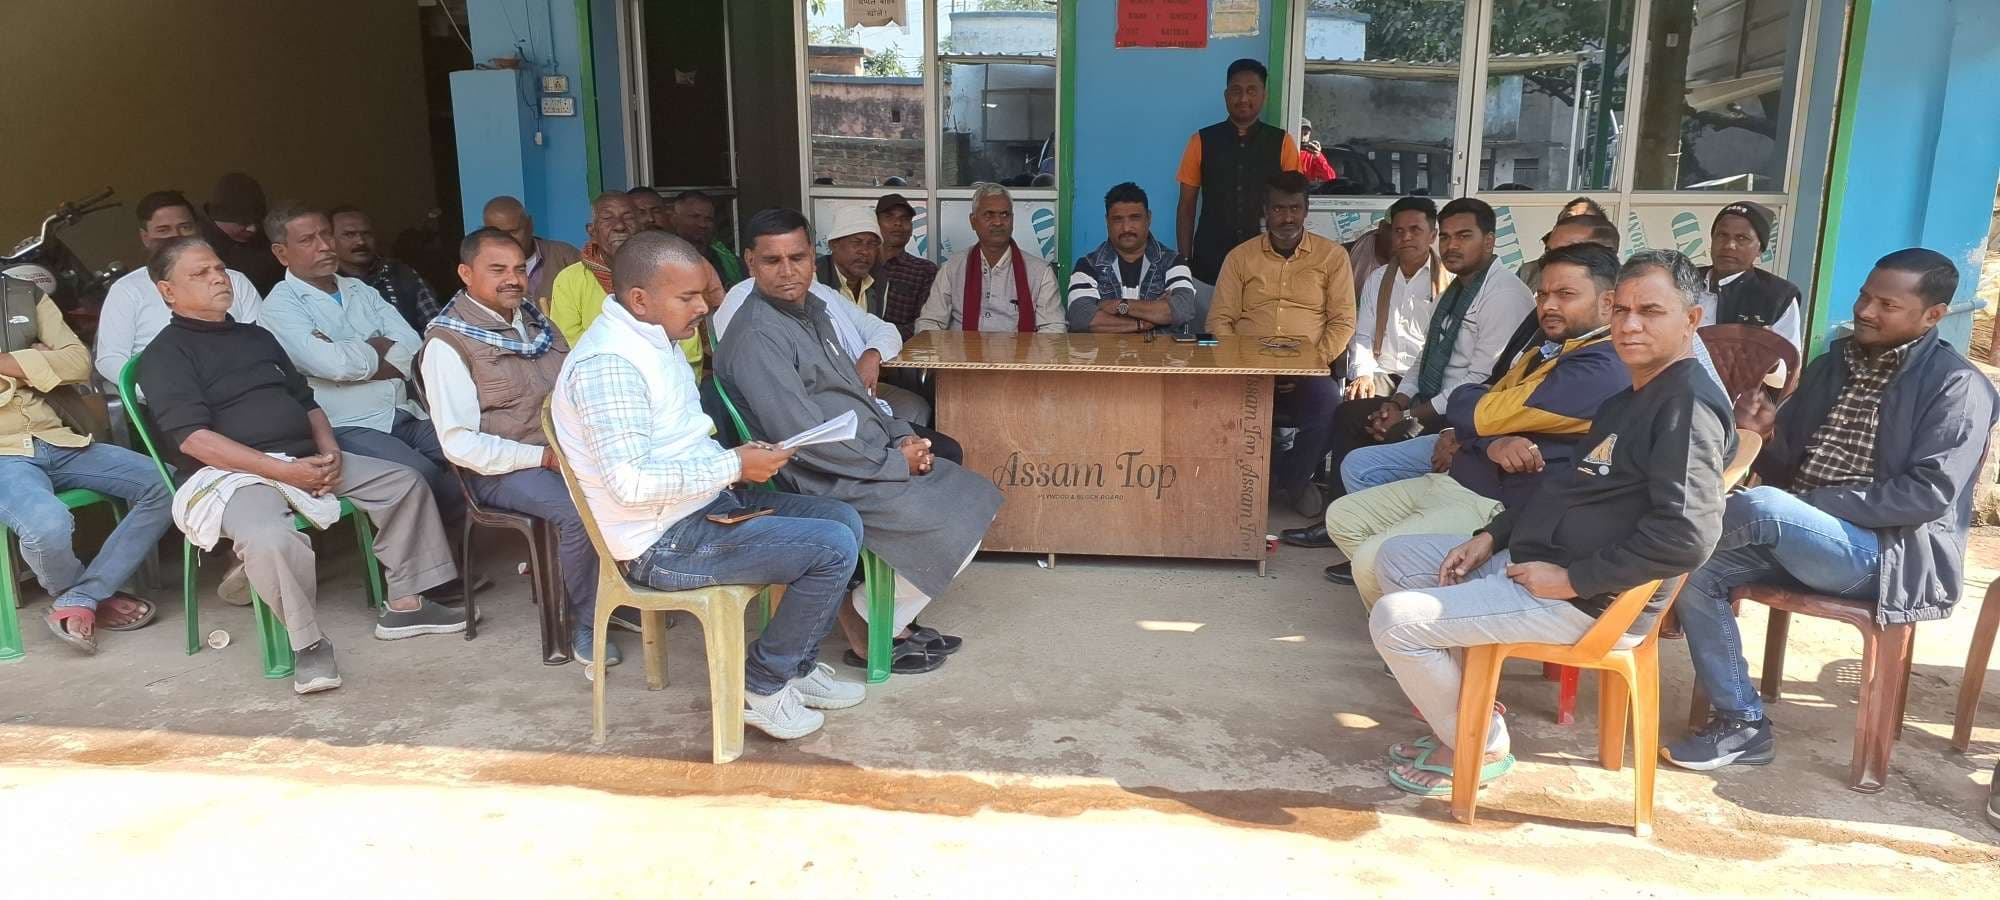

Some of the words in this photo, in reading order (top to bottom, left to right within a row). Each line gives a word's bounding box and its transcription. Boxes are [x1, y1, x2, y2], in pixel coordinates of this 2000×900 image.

[1244, 376, 1264, 421] ssam
[992, 450, 1105, 491] Assam
[1115, 448, 1177, 500] Top
[1236, 458, 1260, 519] Assam
